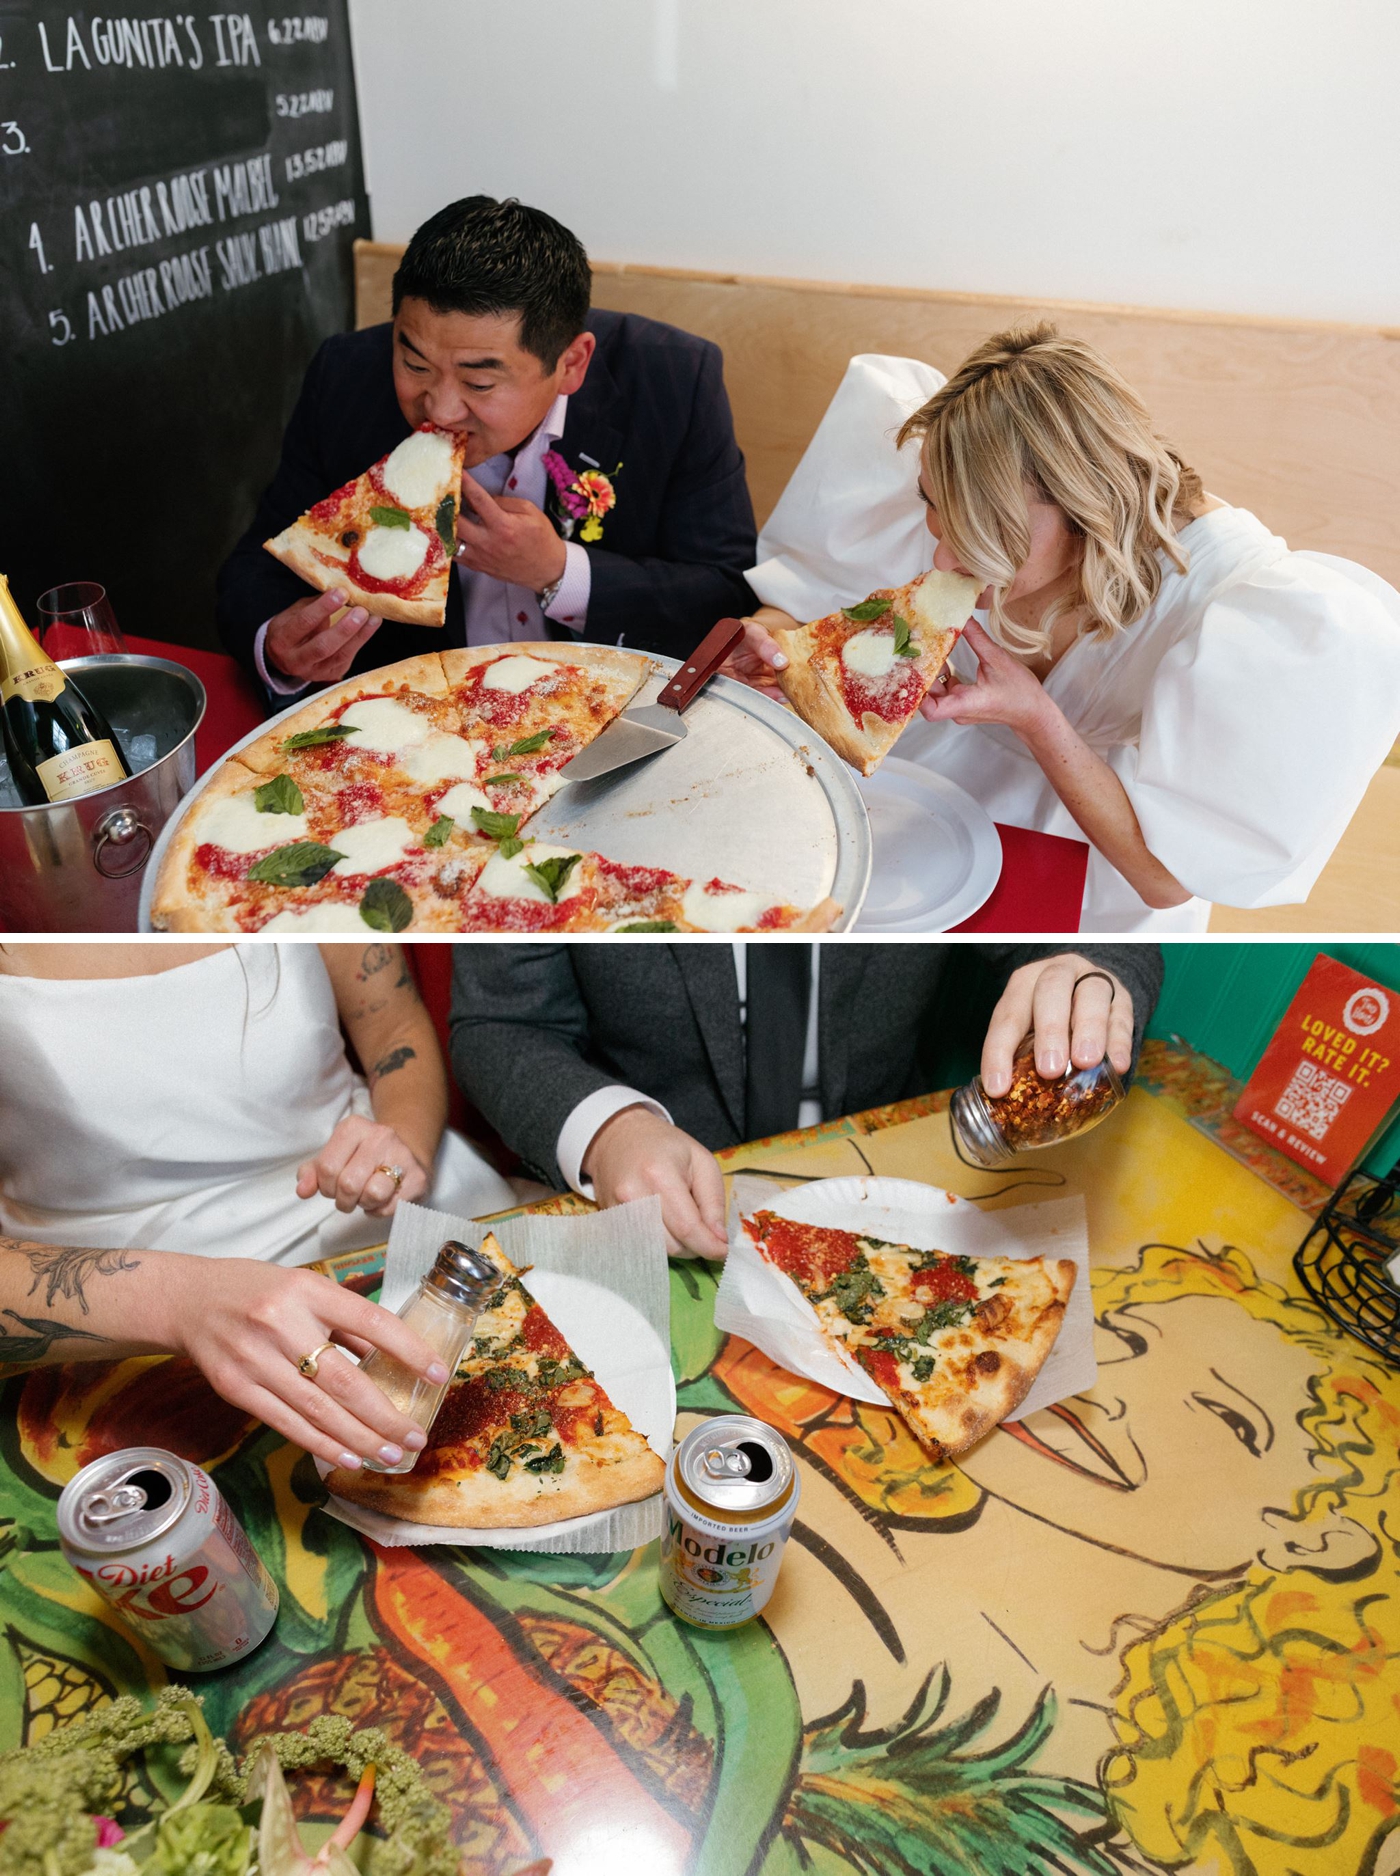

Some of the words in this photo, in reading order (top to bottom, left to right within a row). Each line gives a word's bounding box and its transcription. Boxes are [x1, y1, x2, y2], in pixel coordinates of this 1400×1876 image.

[208, 14, 261, 67] IPA
[0, 121, 31, 154] 3.
[75, 185, 162, 262] ARCHER
[49, 308, 76, 347] 5.
[87, 267, 166, 341] ARCHER
[13, 665, 56, 685] KRUG
[56, 757, 110, 785] KRUG
[58, 749, 99, 769] CHAMPAGNE
[1301, 1014, 1357, 1055] LOVED
[1359, 1047, 1390, 1073] IT?
[1301, 1036, 1347, 1072] RATE
[1347, 1063, 1371, 1088] IT.
[1251, 1110, 1278, 1133] SCAN
[1277, 1128, 1287, 1140] &
[1286, 1134, 1328, 1165] REVIEW
[667, 1505, 776, 1568] Modelo
[690, 1511, 727, 1532] IMPORTED
[98, 1554, 176, 1588] Diet
[669, 1572, 753, 1608] Especial
